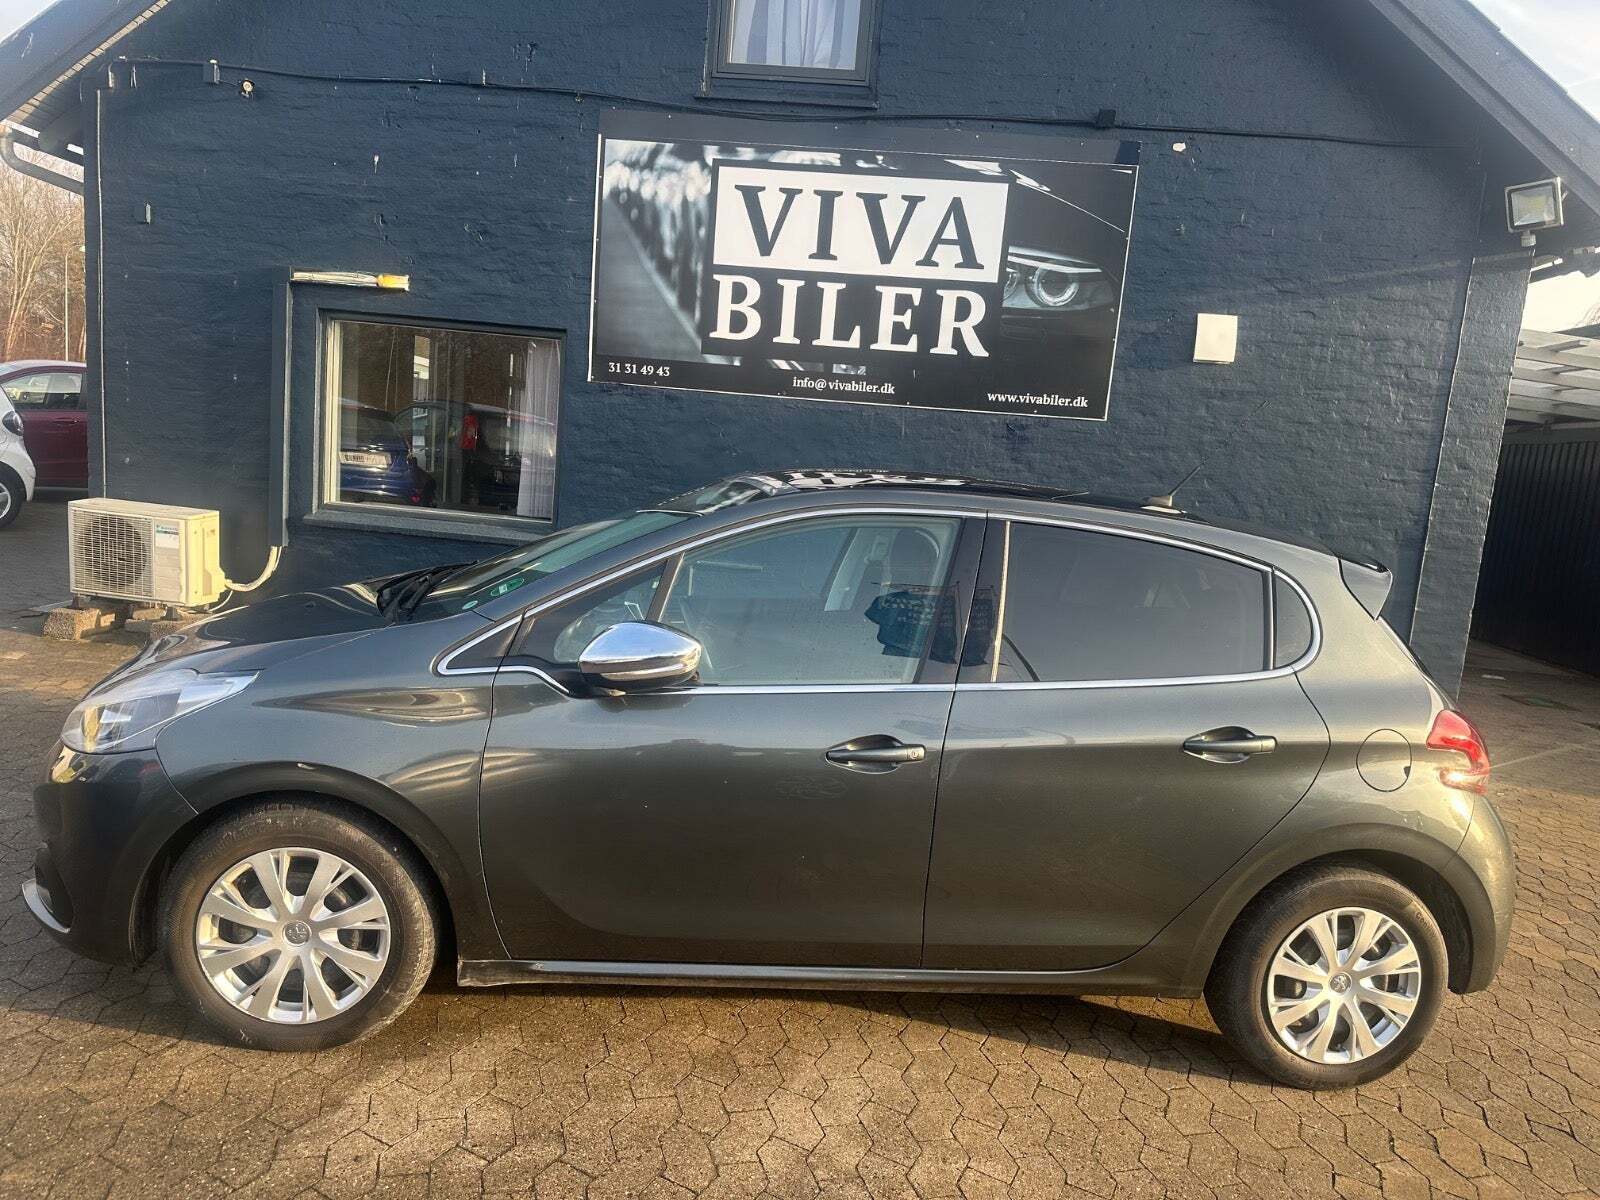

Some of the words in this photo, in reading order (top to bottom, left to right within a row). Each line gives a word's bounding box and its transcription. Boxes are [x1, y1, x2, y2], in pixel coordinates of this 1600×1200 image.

[734, 184, 985, 270] VIVA
[709, 274, 990, 358] BILER
[608, 362, 621, 373] 31
[624, 363, 637, 374] 31
[640, 364, 654, 375] 49
[656, 366, 670, 377] 43
[987, 392, 1089, 408] www.vivabiler.dk
